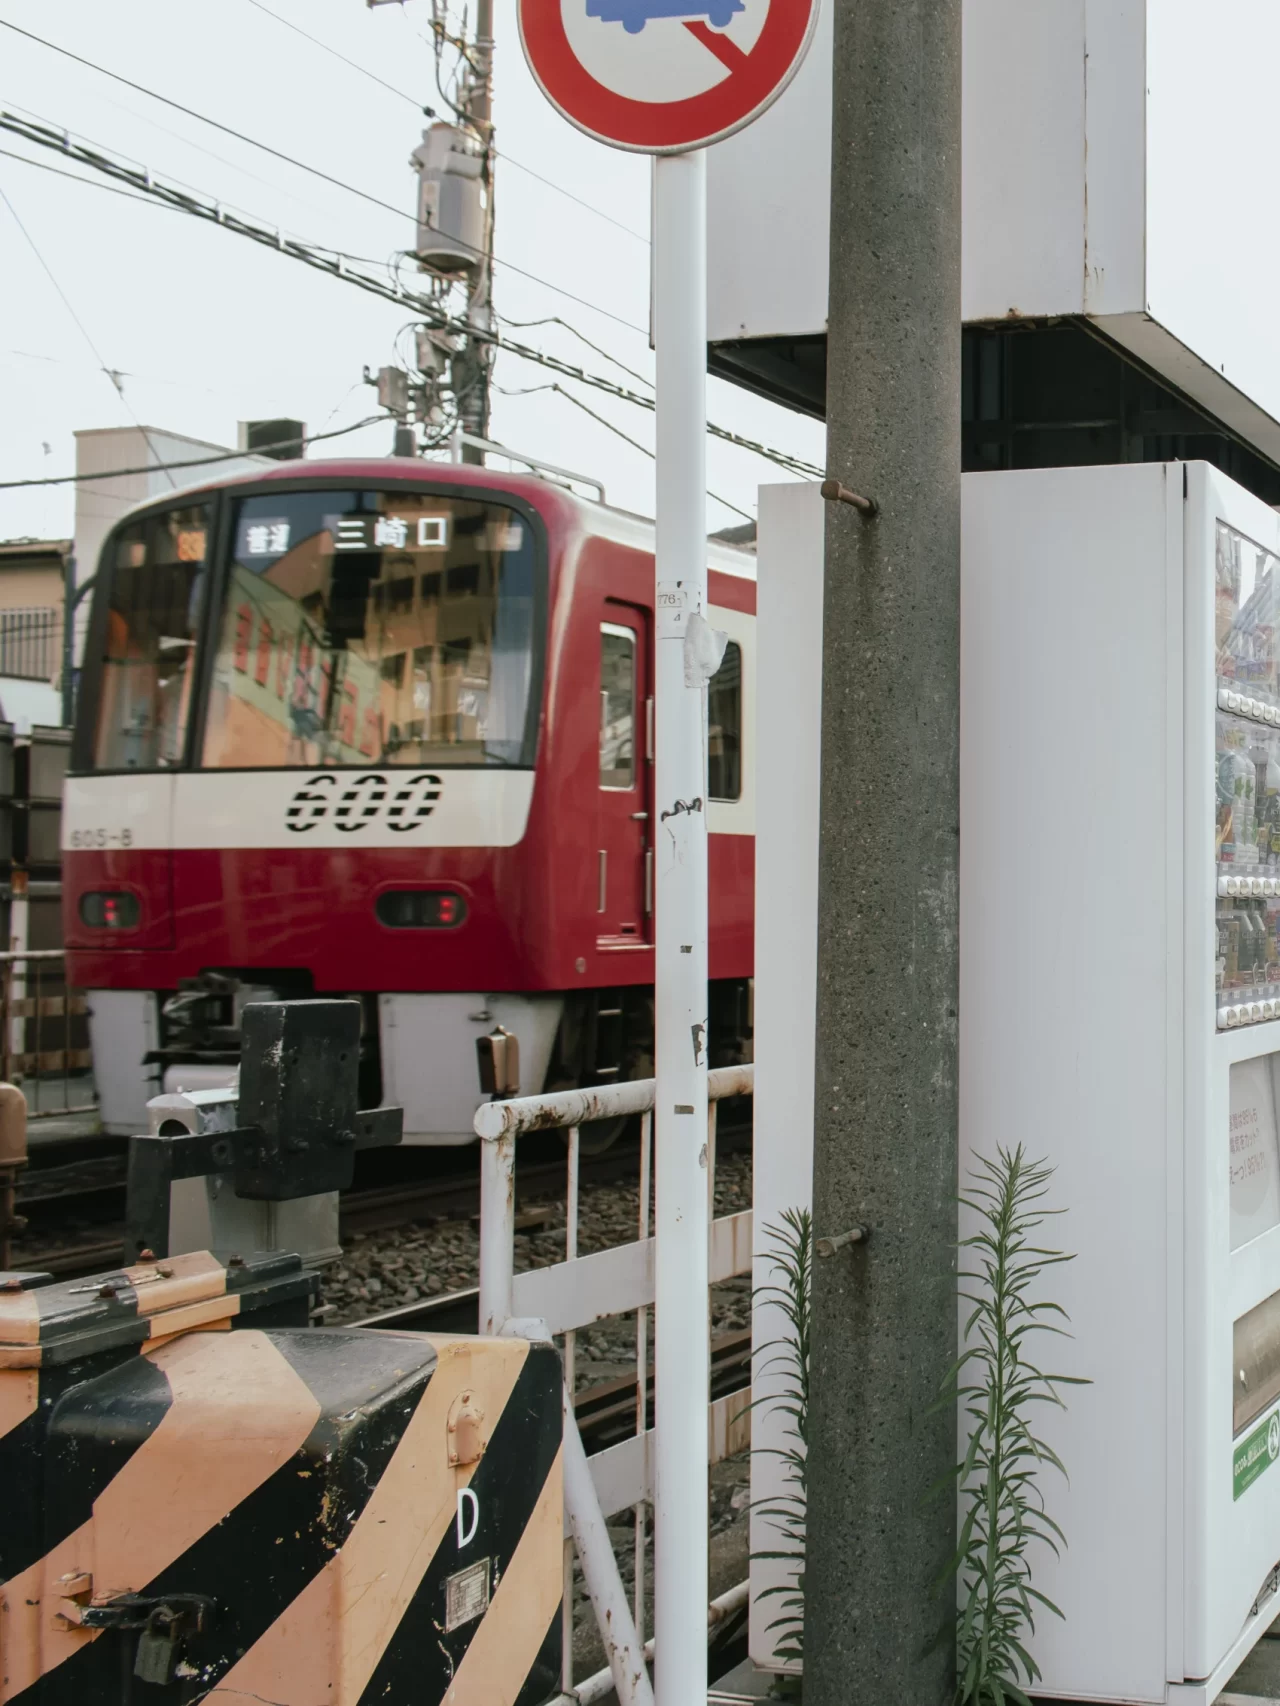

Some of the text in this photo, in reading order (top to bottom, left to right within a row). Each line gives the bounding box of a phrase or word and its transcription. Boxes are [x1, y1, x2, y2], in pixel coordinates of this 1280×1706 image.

[334, 516, 447, 550] 三崎口
[285, 774, 444, 832] 600
[456, 1487, 480, 1549] D
